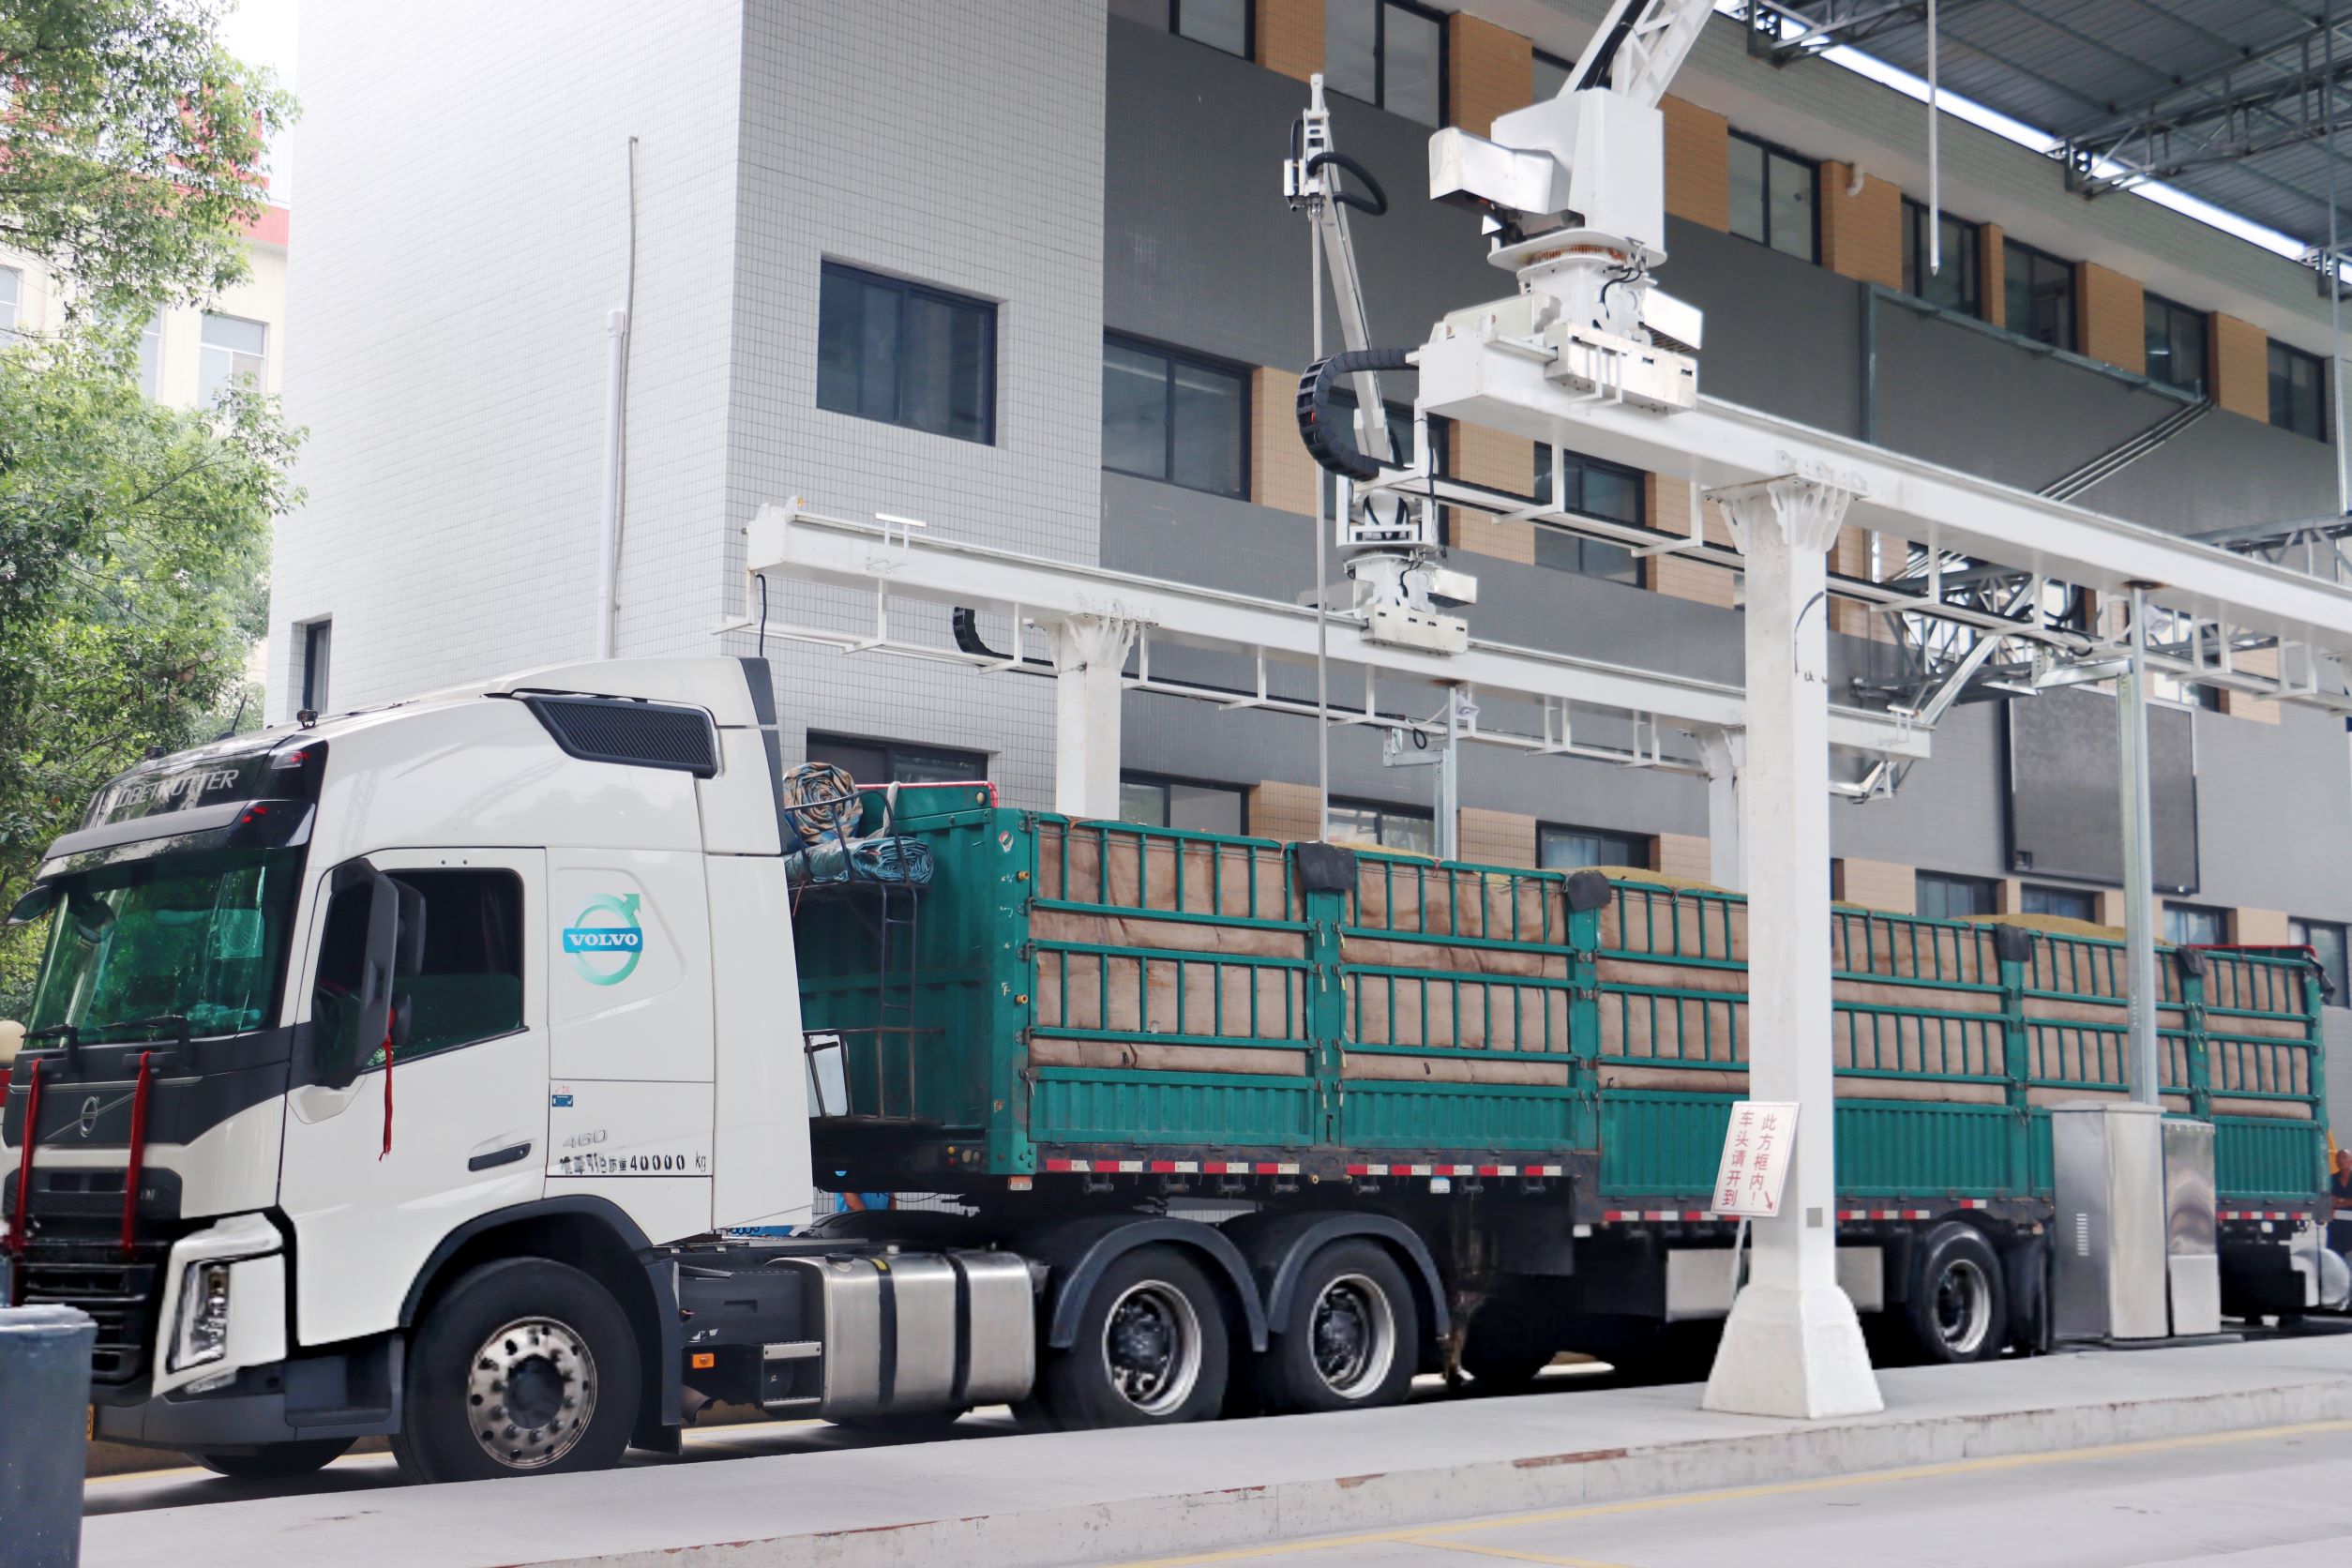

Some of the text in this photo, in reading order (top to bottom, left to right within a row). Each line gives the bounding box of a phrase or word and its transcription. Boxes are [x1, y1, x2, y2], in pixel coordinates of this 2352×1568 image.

[568, 933, 639, 946] VOLVO
[563, 1129, 609, 1149] 460
[695, 1150, 707, 1173] kg
[1722, 1110, 1755, 1207] 车头请开到
